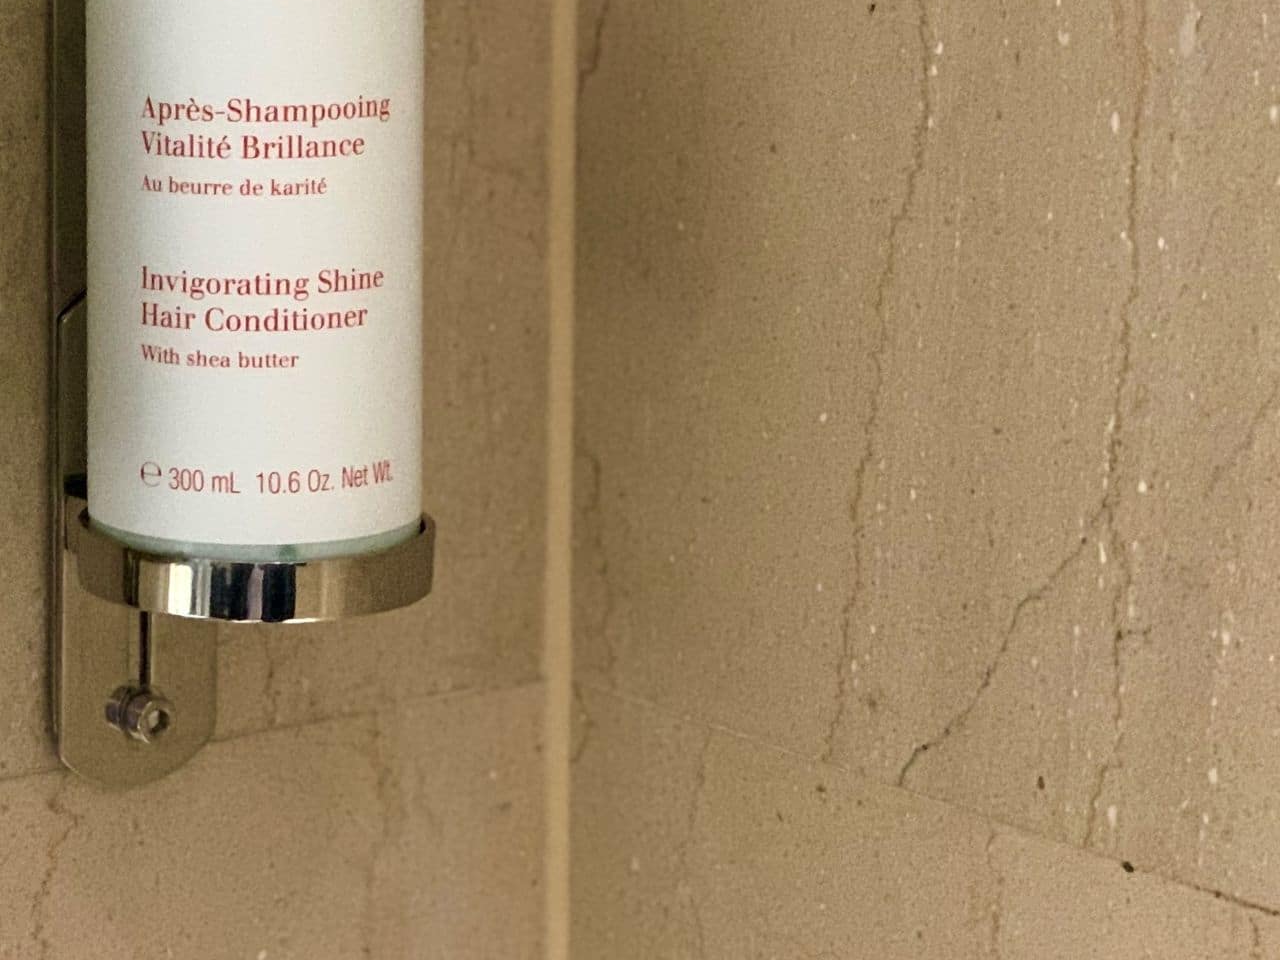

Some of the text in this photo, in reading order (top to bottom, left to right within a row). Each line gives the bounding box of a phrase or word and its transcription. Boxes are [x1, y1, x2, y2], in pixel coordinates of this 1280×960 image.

[141, 95, 391, 128] Après-Shampooing
[141, 130, 365, 160] Vitalité Brillance
[141, 174, 328, 197] Au beurre de karité
[141, 266, 385, 302] Invigorating Shine
[141, 302, 368, 332] Hair Conditioner
[141, 344, 300, 368] With shea butter
[168, 467, 205, 493] 300
[211, 470, 241, 494] mL
[256, 470, 301, 494] 10.6
[307, 469, 335, 493] Oz.
[341, 465, 369, 489] Net
